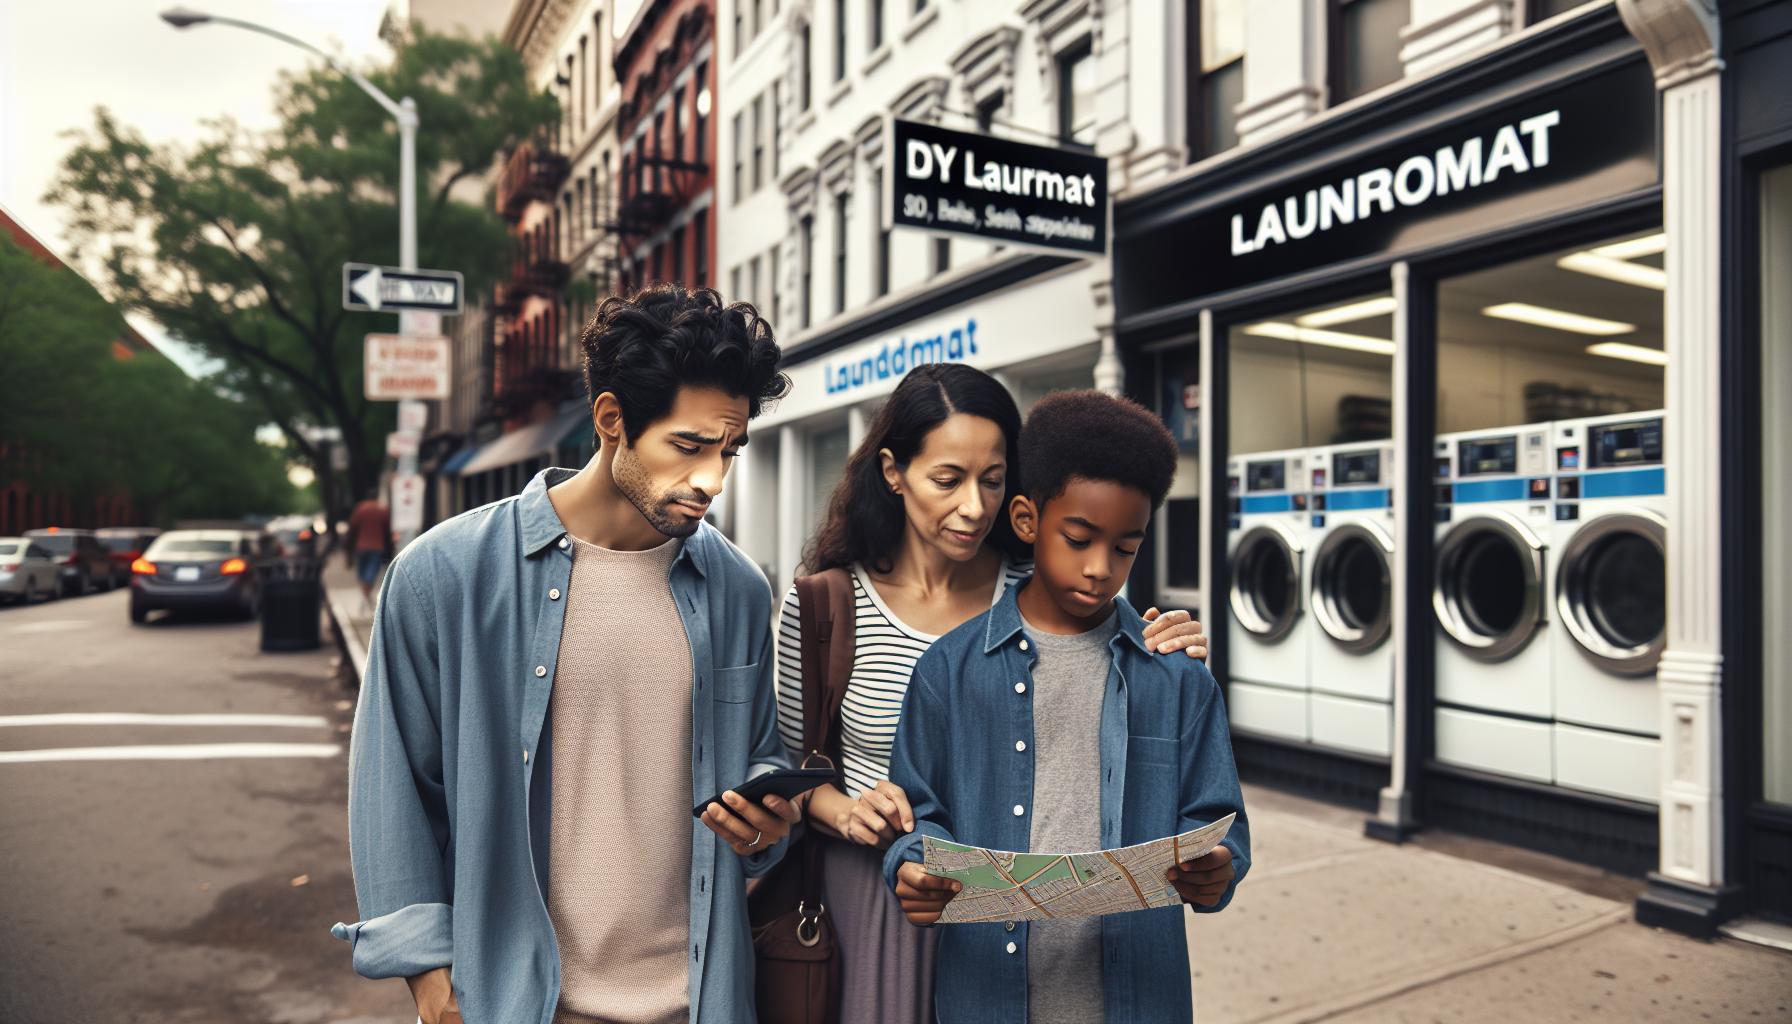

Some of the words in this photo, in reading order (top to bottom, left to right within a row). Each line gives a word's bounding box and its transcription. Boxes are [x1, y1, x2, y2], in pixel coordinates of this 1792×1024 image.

[906, 138, 958, 183] DY
[964, 150, 1096, 207] Laurmat
[1231, 110, 1560, 256] LAUNROMAT
